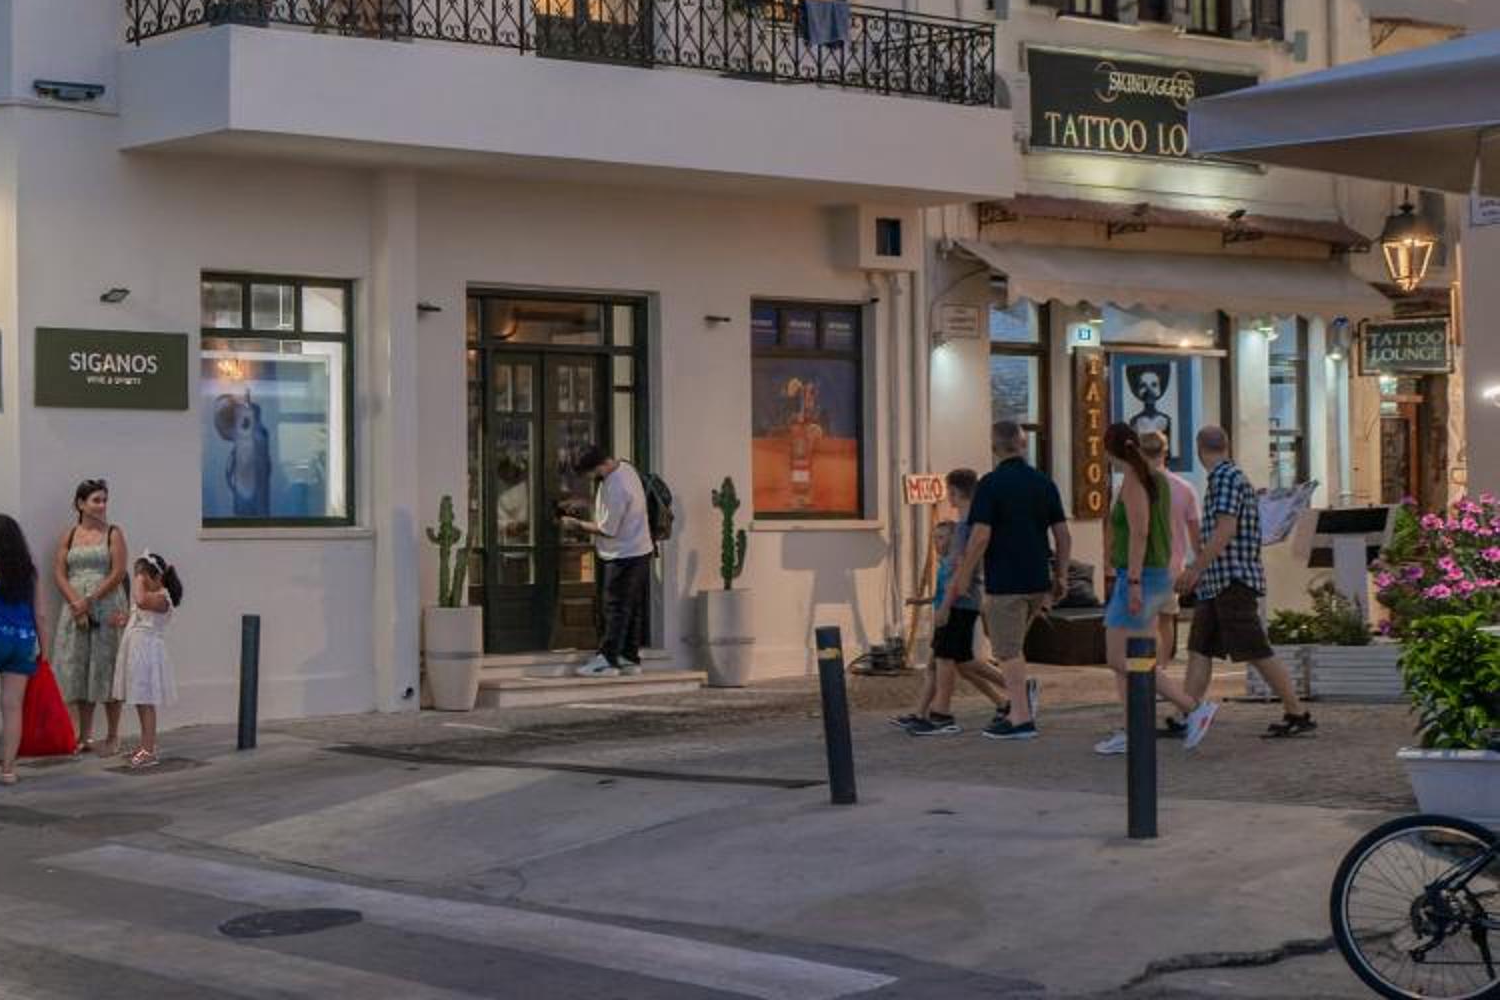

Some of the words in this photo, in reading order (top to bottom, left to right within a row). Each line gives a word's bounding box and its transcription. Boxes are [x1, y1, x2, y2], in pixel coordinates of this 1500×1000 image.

[1045, 111, 1147, 153] TATTOO
[1370, 330, 1445, 346] TATTOO
[69, 351, 158, 375] SIGANOS
[1370, 346, 1444, 364] LOUNGE
[1085, 354, 1102, 511] TATTOO
